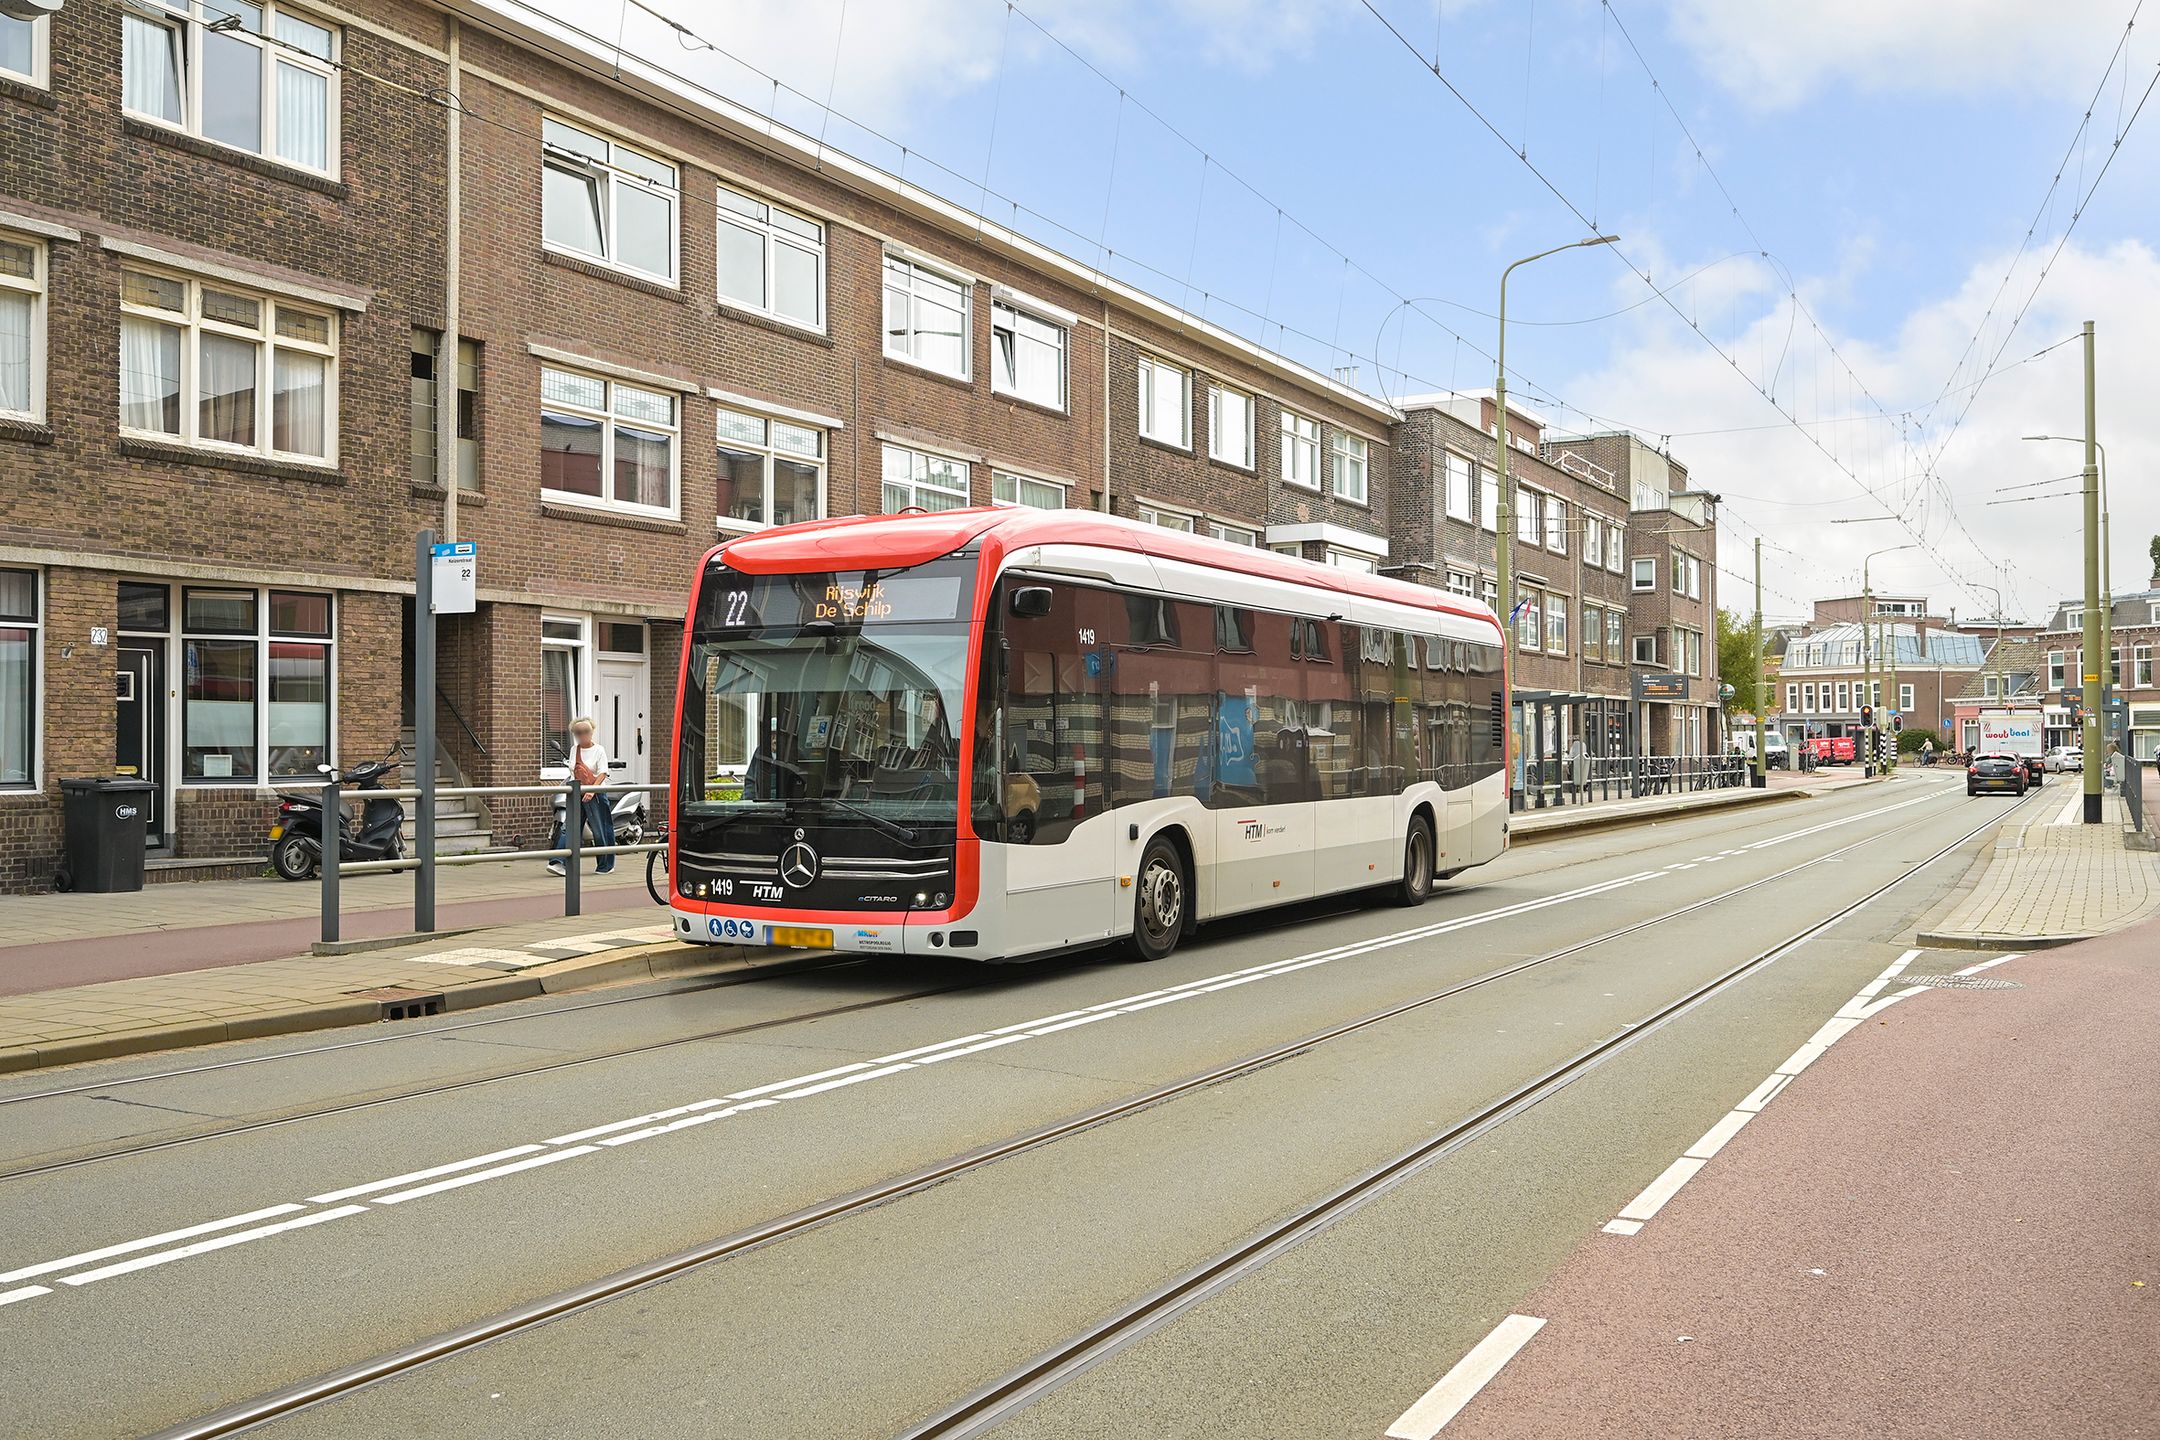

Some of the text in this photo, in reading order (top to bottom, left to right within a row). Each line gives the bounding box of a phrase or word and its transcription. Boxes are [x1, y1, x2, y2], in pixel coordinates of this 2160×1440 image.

[461, 569, 471, 578] 22
[825, 584, 886, 606] Rijswijk
[725, 591, 749, 626] 22
[815, 601, 892, 619] De Schilp
[91, 628, 107, 643] 232
[1078, 628, 1095, 645] 1419
[1985, 729, 2009, 739] wout
[120, 807, 137, 815] HMS
[1245, 824, 1263, 839] HTM
[710, 879, 784, 899] 1419 HTM
